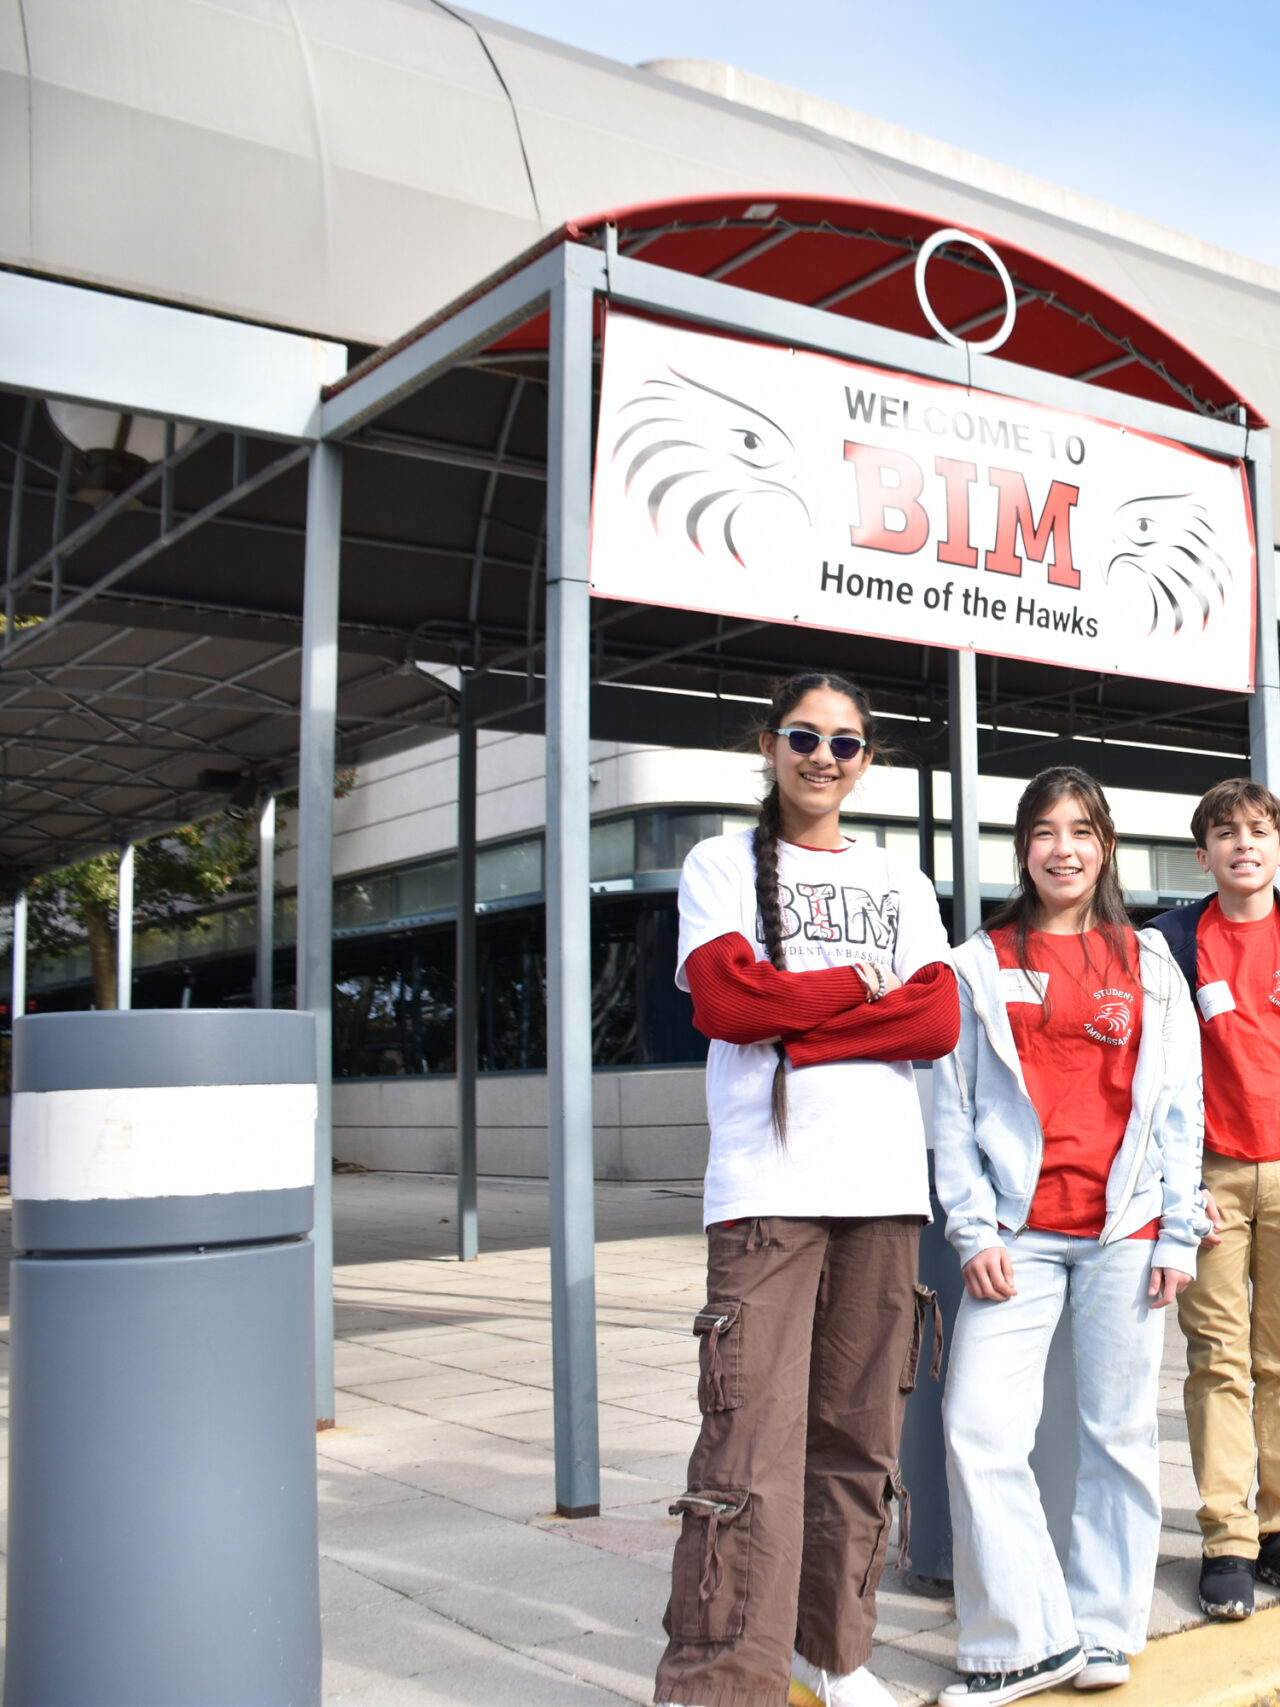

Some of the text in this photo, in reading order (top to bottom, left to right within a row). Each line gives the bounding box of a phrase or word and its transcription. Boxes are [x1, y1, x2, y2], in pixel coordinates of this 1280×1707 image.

[844, 385, 1086, 466] WELCOME TO
[843, 439, 1082, 591] BIM
[820, 560, 1099, 639] Home of the Hawks
[756, 882, 900, 949] BIM
[1093, 988, 1134, 1003] STUDENT
